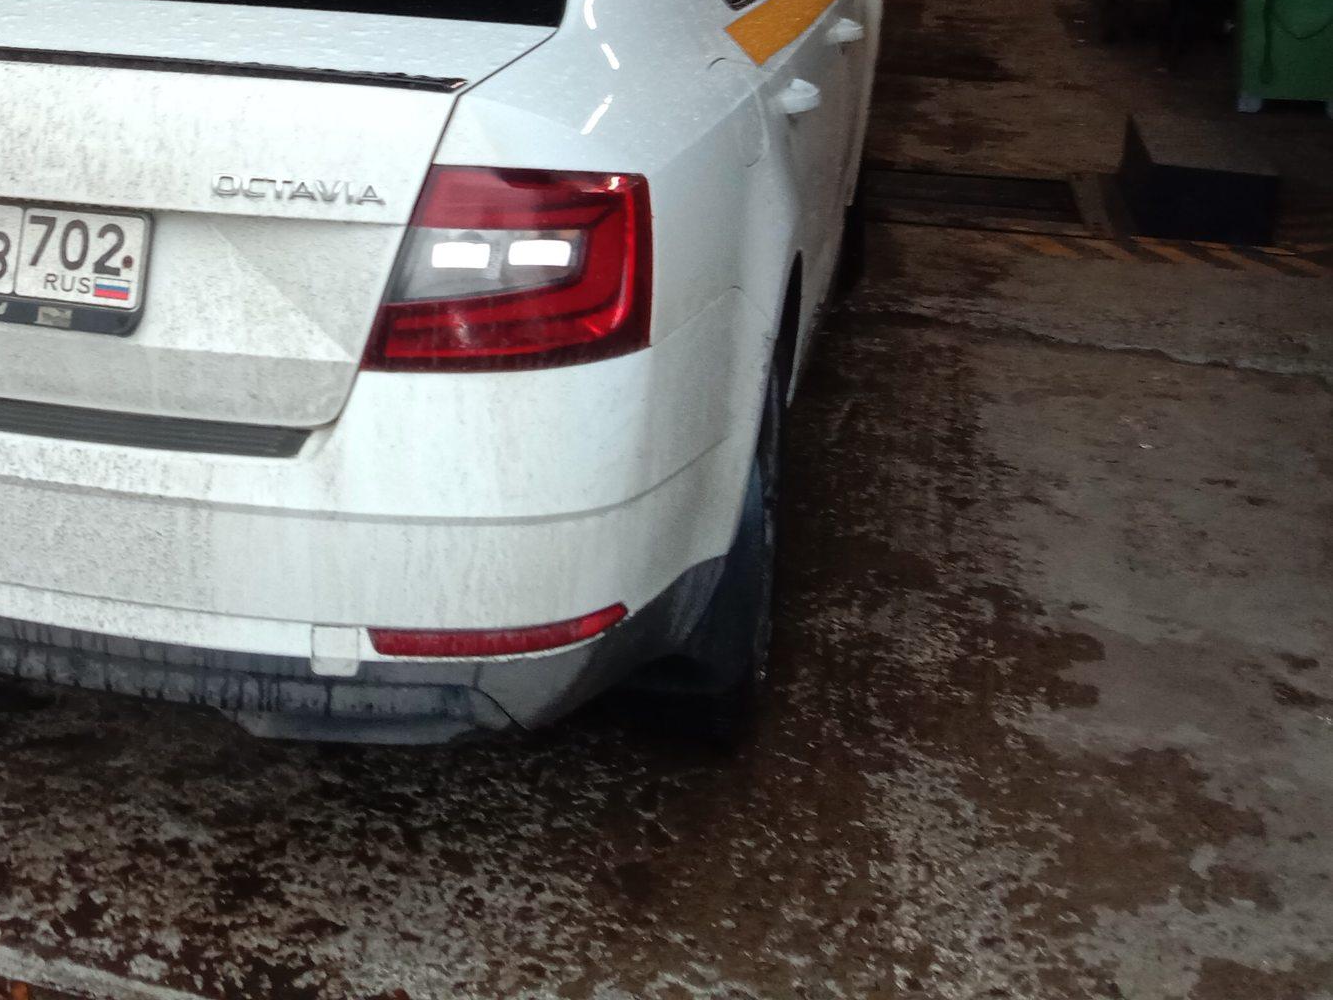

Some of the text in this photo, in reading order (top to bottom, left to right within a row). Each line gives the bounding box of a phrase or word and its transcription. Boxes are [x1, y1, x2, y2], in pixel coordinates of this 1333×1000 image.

[212, 173, 386, 206] OCTAVIA
[27, 214, 126, 277] 702
[43, 273, 91, 295] RUS
